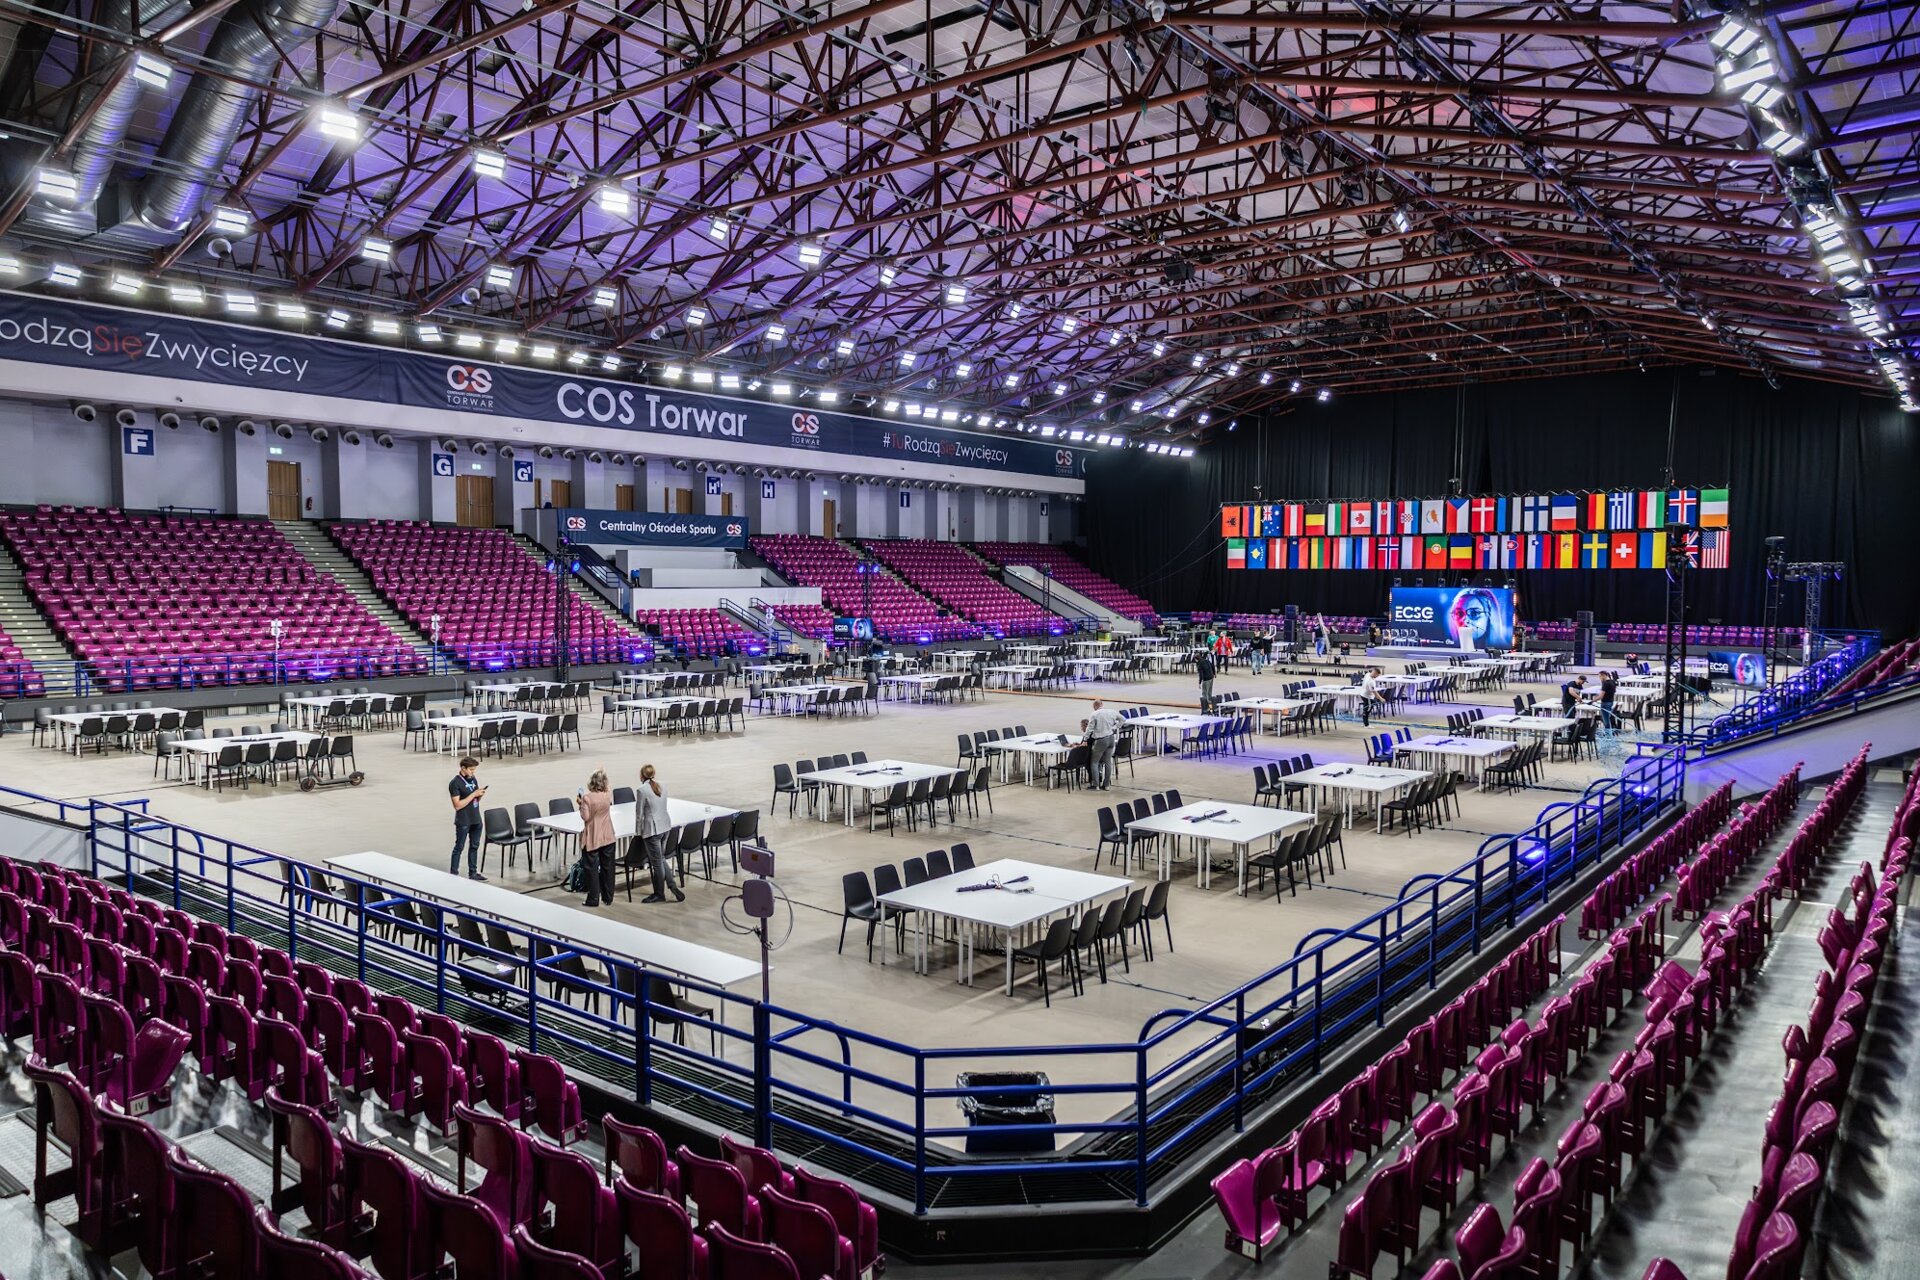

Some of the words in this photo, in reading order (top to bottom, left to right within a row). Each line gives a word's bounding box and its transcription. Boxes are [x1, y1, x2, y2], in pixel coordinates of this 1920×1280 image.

[447, 395, 494, 408] TORWAR
[557, 382, 636, 425] COS
[644, 394, 748, 437] Torwar
[131, 433, 149, 453] F
[436, 458, 452, 476] G
[763, 484, 774, 498] H
[599, 520, 647, 534] Centralny
[649, 521, 687, 534] Ośrodek
[689, 523, 717, 536] Sportu
[135, 1101, 144, 1111] IV
